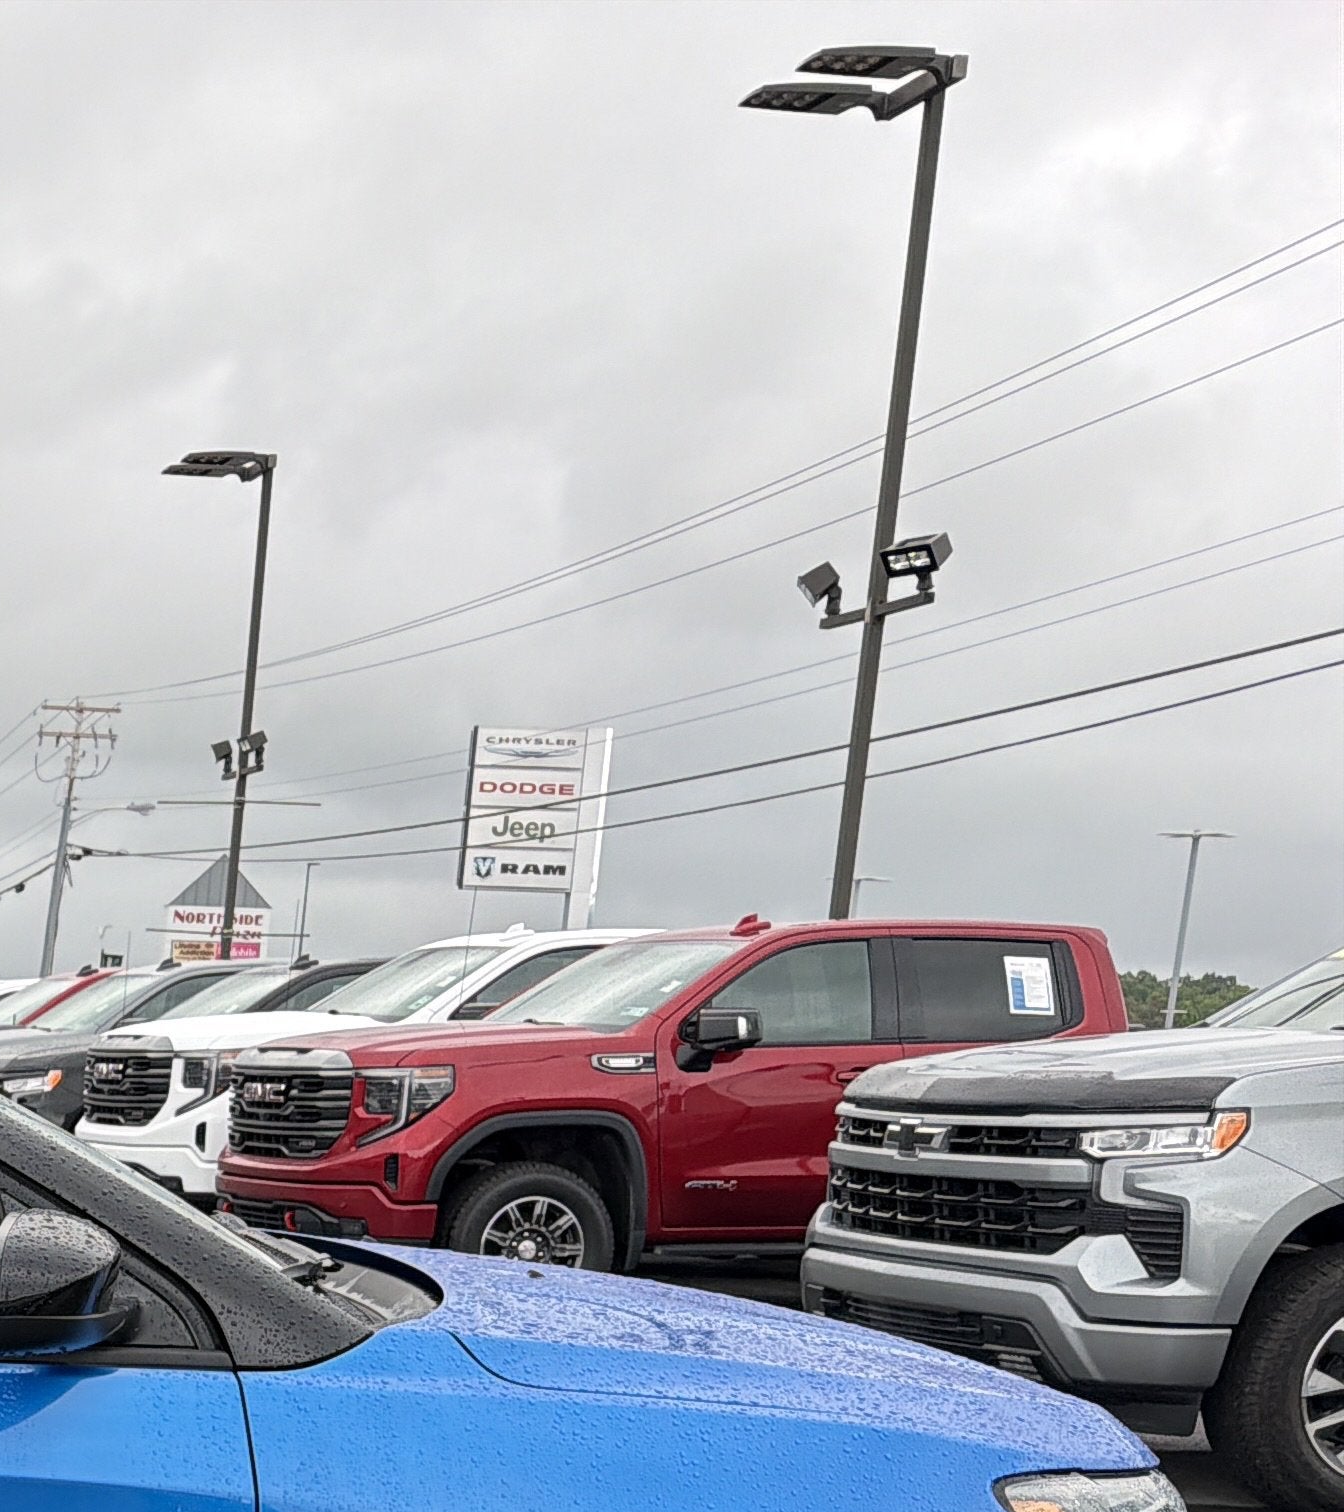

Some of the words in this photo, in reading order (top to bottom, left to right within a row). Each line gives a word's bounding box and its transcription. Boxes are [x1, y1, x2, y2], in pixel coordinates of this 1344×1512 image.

[485, 736, 577, 746] CHRYSLER
[479, 781, 575, 796] DODGE
[491, 815, 556, 843] Jeep
[500, 863, 567, 876] RAM
[243, 1082, 287, 1103] GMC
